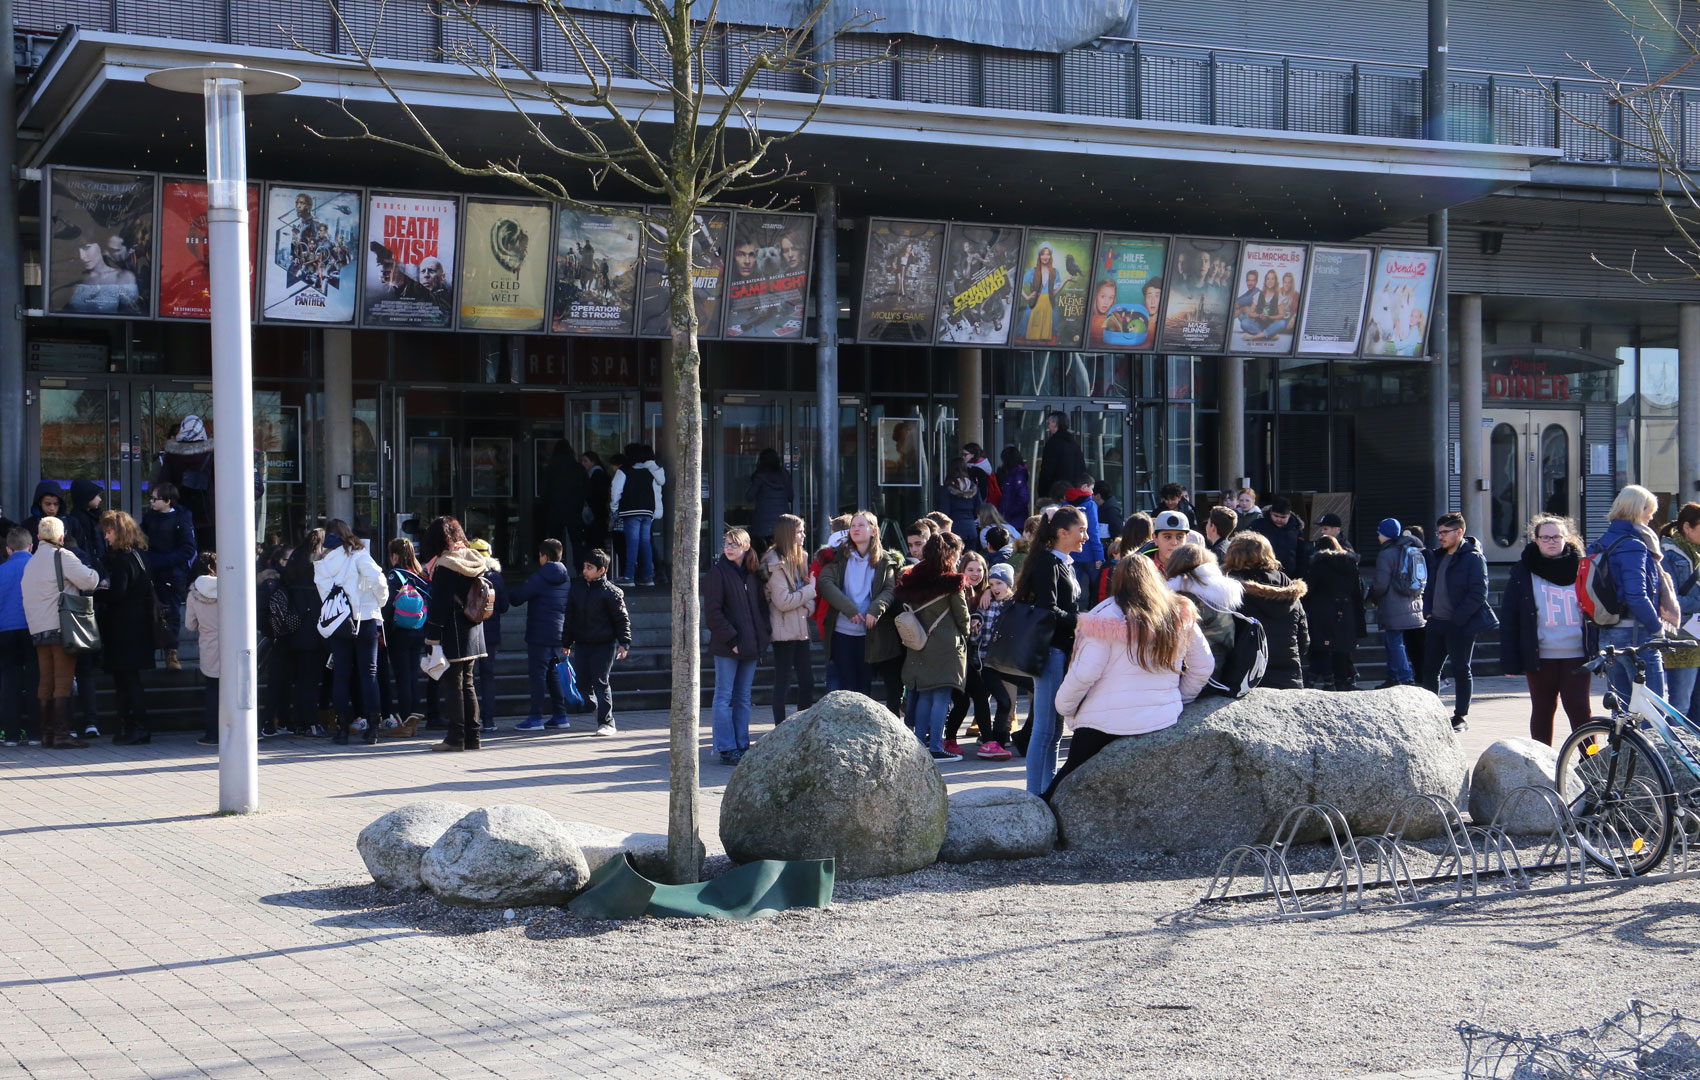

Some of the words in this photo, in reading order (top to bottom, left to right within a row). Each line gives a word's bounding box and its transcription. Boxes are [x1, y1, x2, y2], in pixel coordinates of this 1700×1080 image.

[383, 215, 440, 240] DEATH
[383, 238, 439, 266] WISH
[1122, 252, 1147, 264] HILFE,
[1315, 253, 1343, 265] Streep
[1313, 265, 1341, 275] Hanks
[1385, 260, 1418, 276] Wendy
[1416, 261, 1428, 276] 2
[490, 281, 520, 290] GELD
[692, 276, 718, 289] MUTER
[730, 282, 768, 299] GAME
[769, 274, 807, 293] NIGHT
[953, 264, 1008, 307] CRIMINAL
[490, 293, 519, 303] WELT
[967, 276, 1006, 309] SQUAD
[295, 296, 326, 307] PANTHER
[570, 305, 622, 313] OPERATION:
[1063, 304, 1085, 317] HEXE
[871, 311, 902, 320] MOLLY'S
[902, 311, 926, 321] GAME
[1489, 373, 1570, 400] DINER
[266, 460, 295, 468] NICHT.
